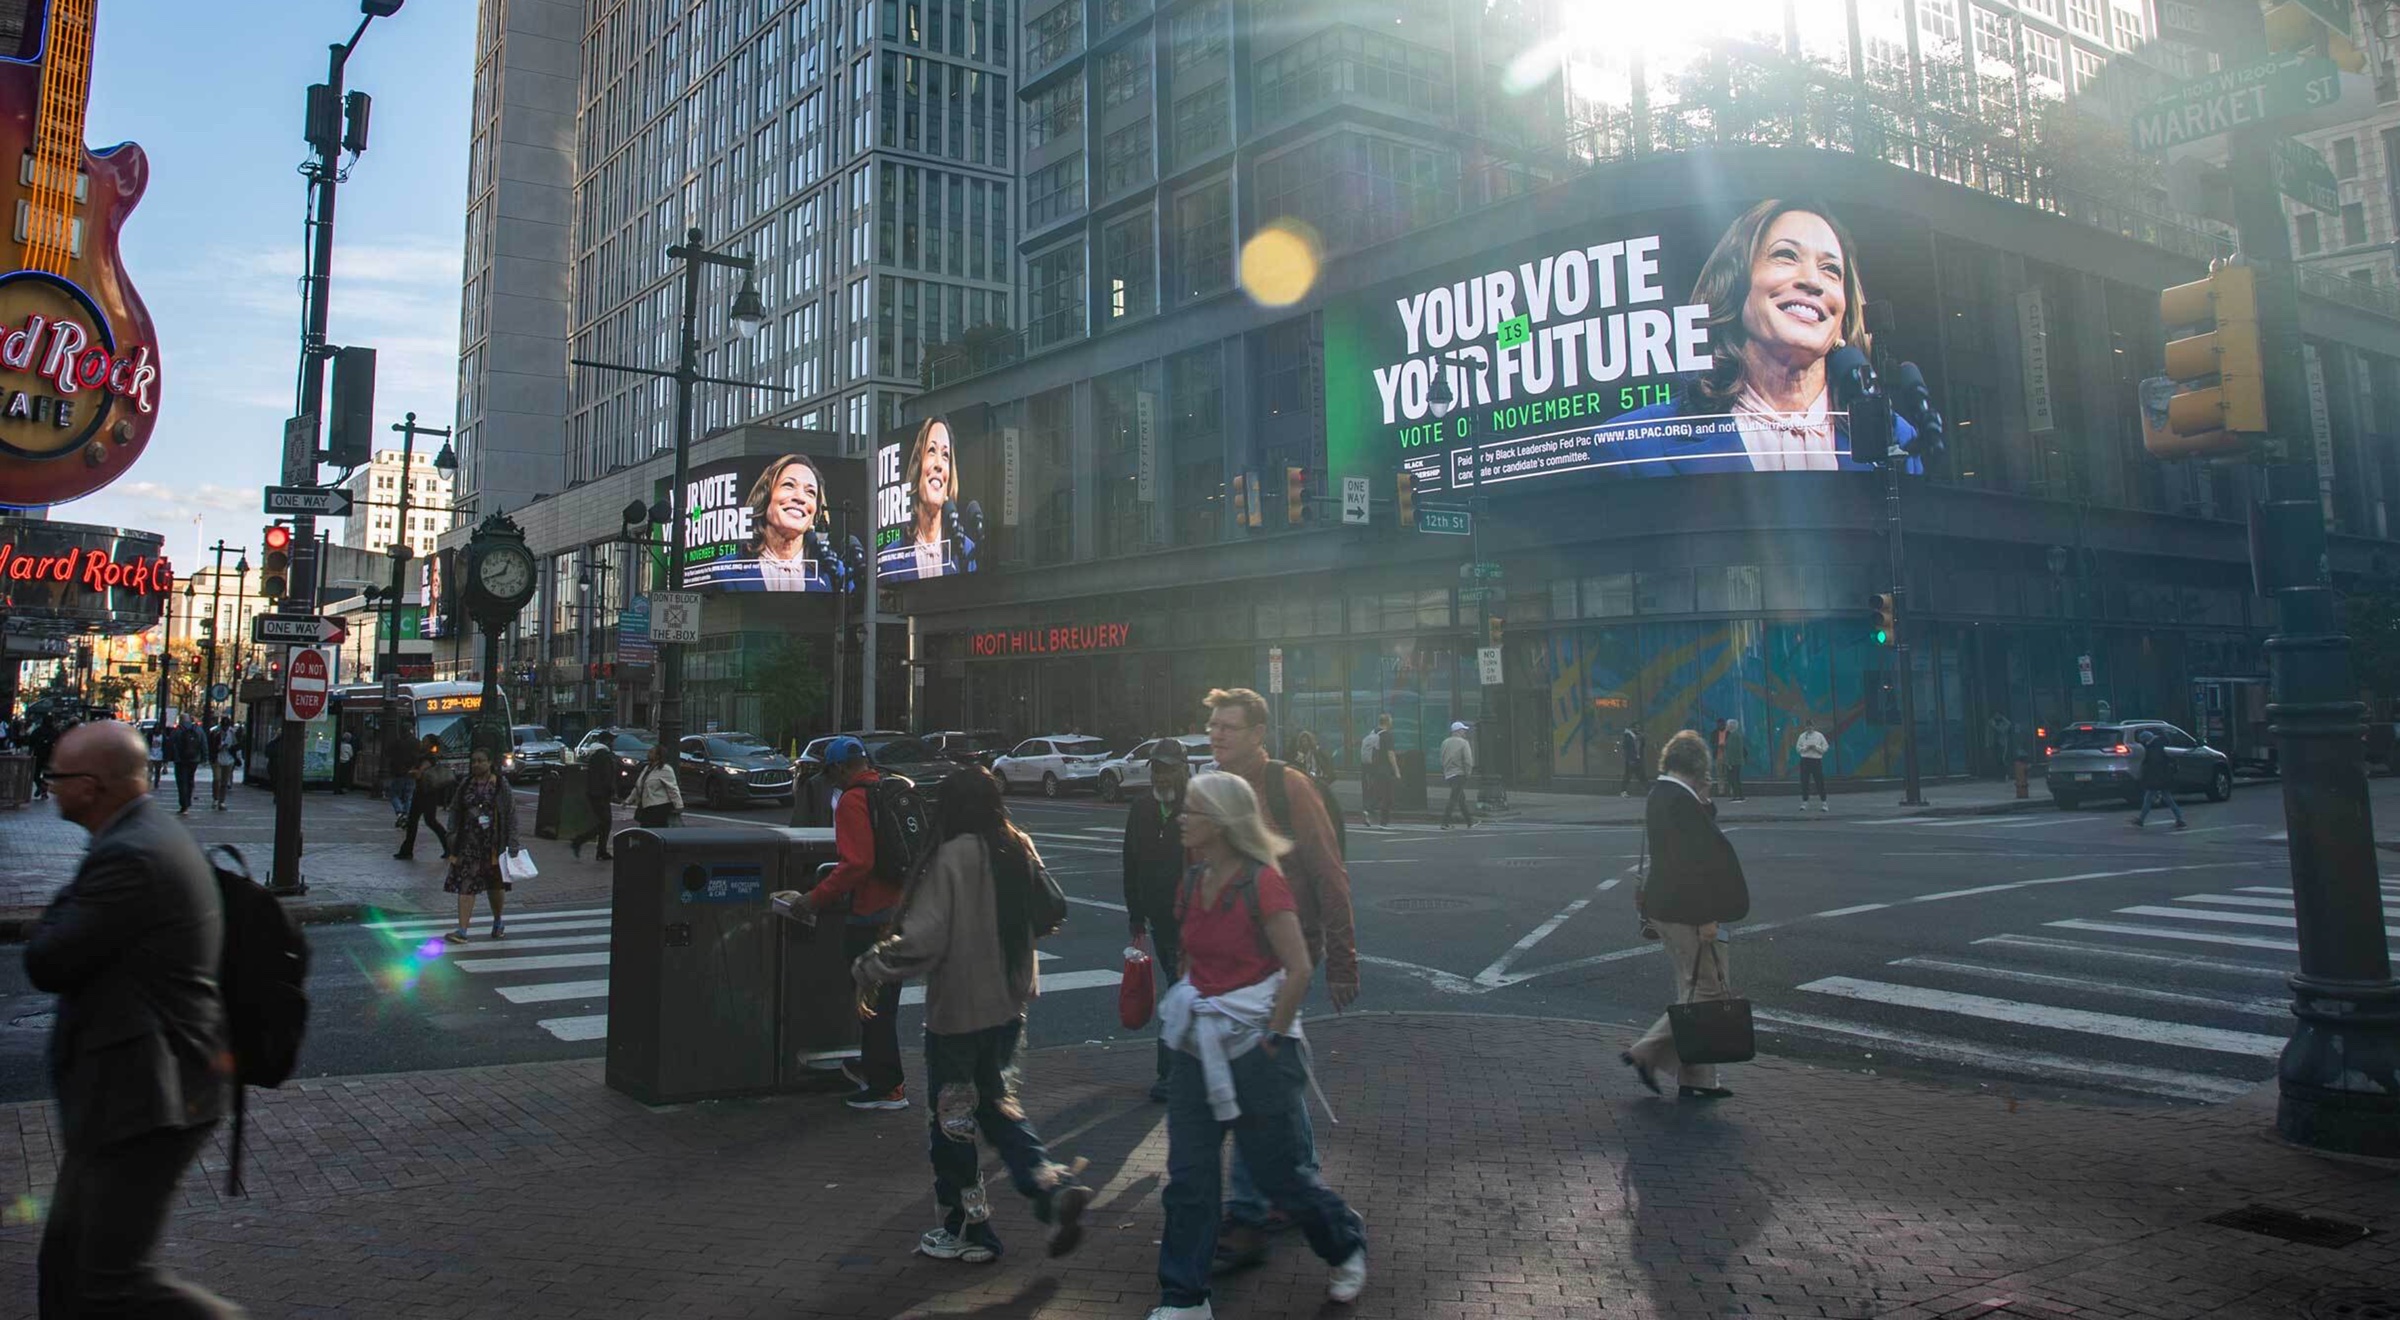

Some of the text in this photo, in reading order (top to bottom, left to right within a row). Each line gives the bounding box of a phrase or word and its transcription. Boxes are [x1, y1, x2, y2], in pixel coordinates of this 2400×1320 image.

[2219, 72, 2235, 90] W
[2237, 62, 2277, 84] 1200
[2136, 75, 2333, 149] MARKET ST
[1396, 235, 1664, 355] YOUR VOTE
[1504, 322, 1522, 341] IS
[1496, 303, 1714, 401] FUTURE
[2029, 304, 2048, 417] CITY FITNESS
[39, 319, 156, 415] Rock
[0, 387, 75, 428] AFE
[1399, 422, 1444, 449] VOTE
[1493, 391, 1601, 432] NOVEMBER
[1620, 383, 1672, 411] 5TH
[1484, 452, 1495, 463] by
[1495, 448, 1516, 461] Black
[1517, 442, 1558, 457] Leadership
[1559, 438, 1575, 450] Fed
[1576, 436, 1592, 447] Pac
[1594, 424, 1693, 447] (WWW.BLPAC.ORG)
[1695, 423, 1716, 435] and
[1718, 422, 1737, 433] not
[878, 442, 901, 488] OTE
[1493, 466, 1501, 475] or
[1502, 457, 1545, 473] candidate's
[1546, 451, 1591, 467] committee.
[699, 472, 738, 511] VOTE
[1347, 493, 1365, 503] WAY
[1348, 480, 1365, 492] ONE
[275, 495, 328, 507] ONE WAY
[691, 506, 754, 548] FUTURE
[1425, 515, 1464, 529] 12th St
[886, 528, 901, 543] 5TH
[718, 544, 738, 557] 5TH
[83, 549, 149, 596] Rock
[675, 594, 698, 603] BLOCK
[267, 622, 320, 634] ONE WAY
[653, 629, 696, 640] THE BOX
[971, 622, 1130, 655] IRON HILL BREWERY
[1484, 650, 1495, 658] NO
[294, 662, 324, 676] DO NOT
[295, 694, 319, 706] ENTER
[427, 699, 438, 711] 33
